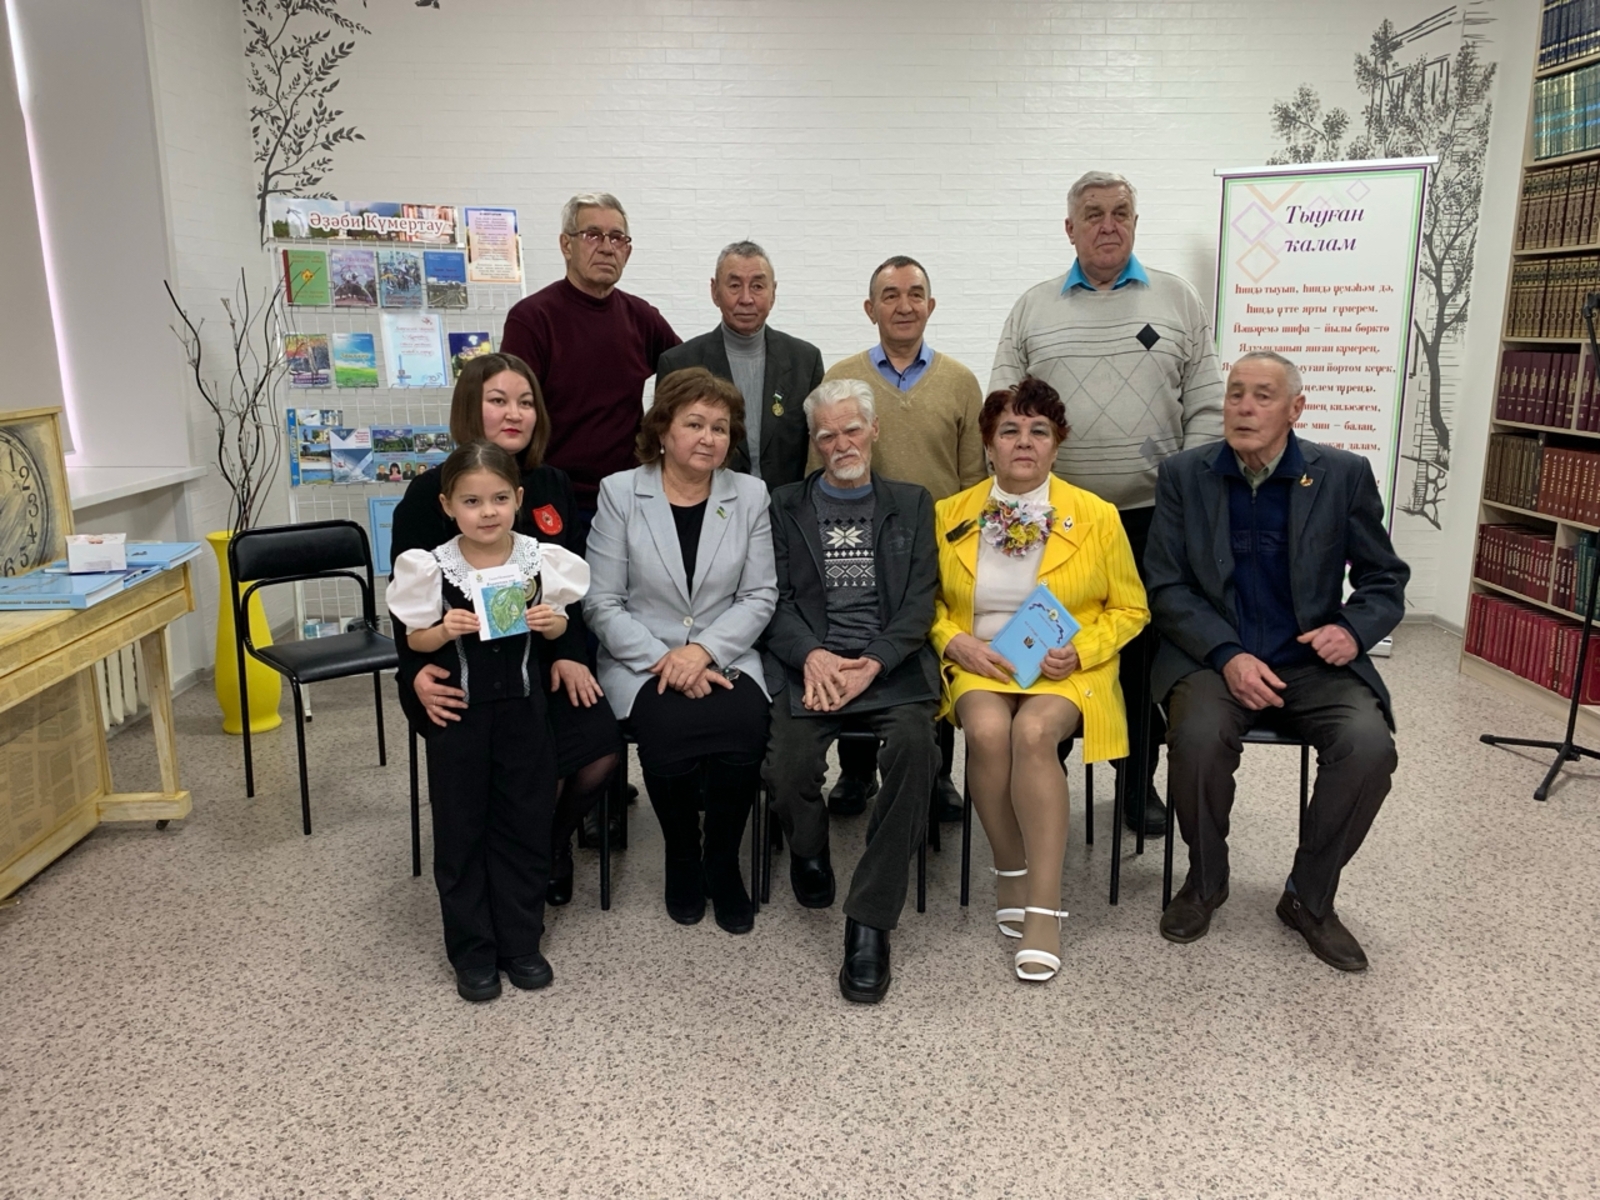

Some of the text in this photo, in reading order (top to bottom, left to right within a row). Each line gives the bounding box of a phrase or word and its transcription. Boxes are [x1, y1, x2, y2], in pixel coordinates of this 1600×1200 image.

[310, 213, 444, 234] Әҙәби Күмертау
[1286, 205, 1364, 228] Тыуған
[1285, 238, 1356, 252] ҡалам
[9, 448, 16, 472] 1
[19, 465, 30, 491] 2
[27, 493, 39, 518] 3
[27, 523, 38, 544] 4
[4, 557, 16, 577] 6
[19, 545, 29, 568] 5
